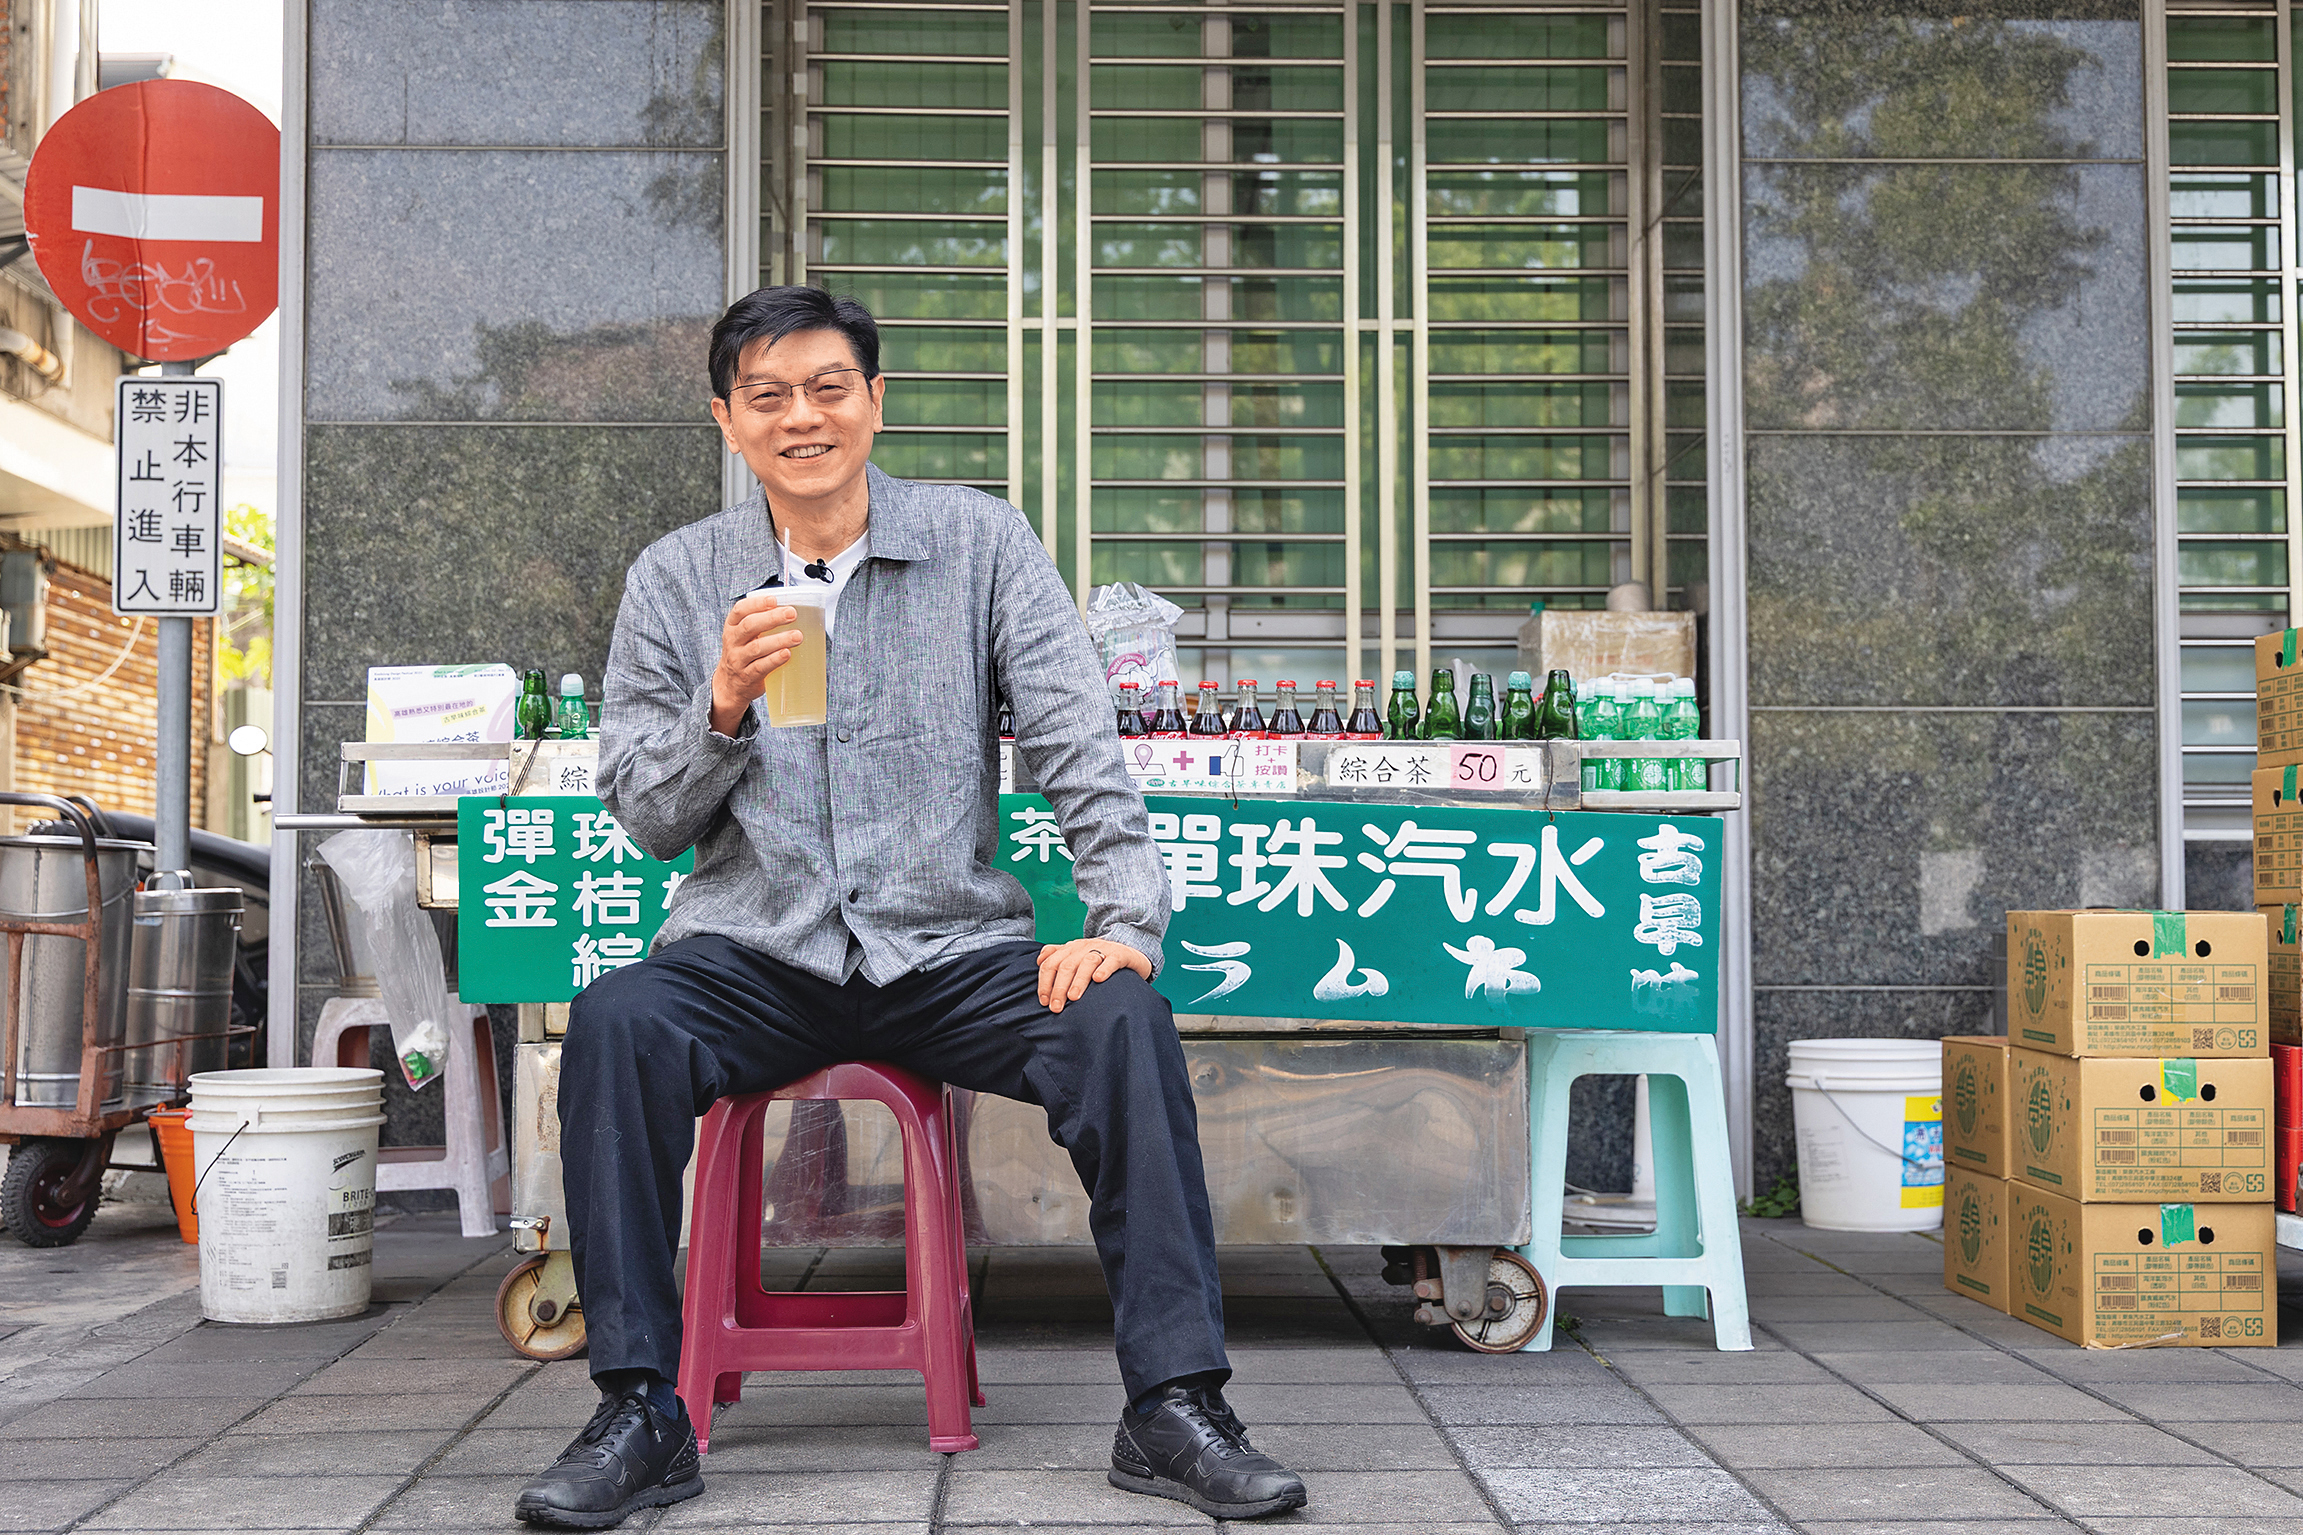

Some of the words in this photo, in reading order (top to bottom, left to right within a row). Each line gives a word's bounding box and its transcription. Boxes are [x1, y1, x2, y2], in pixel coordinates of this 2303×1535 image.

[127, 388, 167, 602] 禁止進入
[169, 390, 211, 604] 非本行車輛
[1255, 744, 1288, 756] 打卡
[415, 783, 427, 795] is
[433, 777, 468, 794] your
[475, 768, 510, 783] voic
[559, 765, 590, 793] 綜
[1255, 764, 1288, 776] 按讚
[1338, 755, 1432, 786] 綜合茶
[1458, 752, 1498, 782] 50
[1511, 763, 1533, 783] 元
[1010, 806, 1076, 863] 茶
